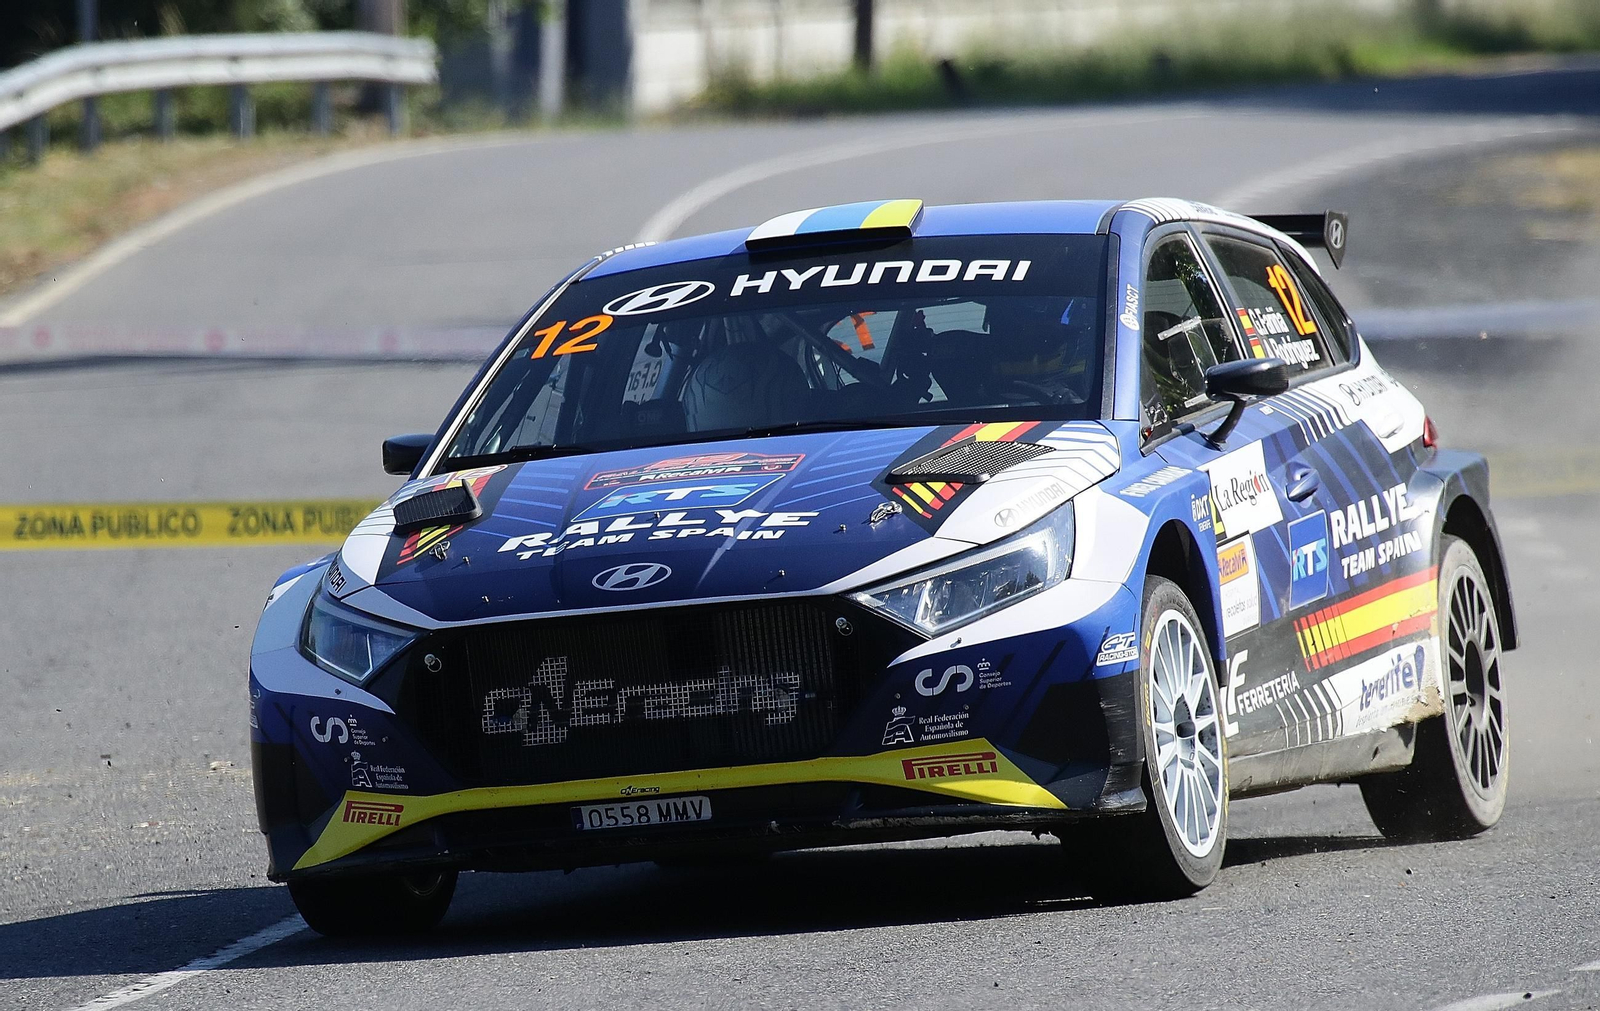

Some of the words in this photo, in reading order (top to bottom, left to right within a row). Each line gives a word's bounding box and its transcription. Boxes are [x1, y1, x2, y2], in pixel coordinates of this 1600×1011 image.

[730, 259, 1032, 297] HYUNDAI
[1266, 264, 1317, 336] 12
[530, 315, 614, 359] 12
[598, 483, 759, 509] RTS
[1016, 482, 1066, 514] HYUNDAI
[1214, 484, 1233, 512] La
[1230, 469, 1270, 507] Región
[14, 510, 87, 540] ZONA
[90, 507, 201, 540] PUBLICO
[226, 504, 296, 538] ZONA
[497, 509, 820, 553] RALLYE
[1330, 482, 1420, 550] RALLYE
[516, 532, 636, 561] TEAM
[648, 527, 786, 541] SPAIN
[1292, 537, 1328, 583] RTS
[1341, 547, 1376, 580] TEAM
[1377, 530, 1423, 566] SPAIN
[1102, 634, 1135, 651] GT
[978, 670, 1001, 678] Consejo
[987, 681, 1012, 689] Deportes
[1236, 670, 1301, 716] FERRETERIA
[918, 715, 933, 725] Real
[934, 711, 969, 723] Federación
[924, 721, 954, 733] Española
[955, 720, 964, 729] de
[920, 729, 969, 742] Automovilismo
[901, 751, 998, 781] PIRELLI
[343, 801, 404, 827] PIRELLI
[588, 804, 650, 829] 0558
[656, 799, 704, 823] MMV
